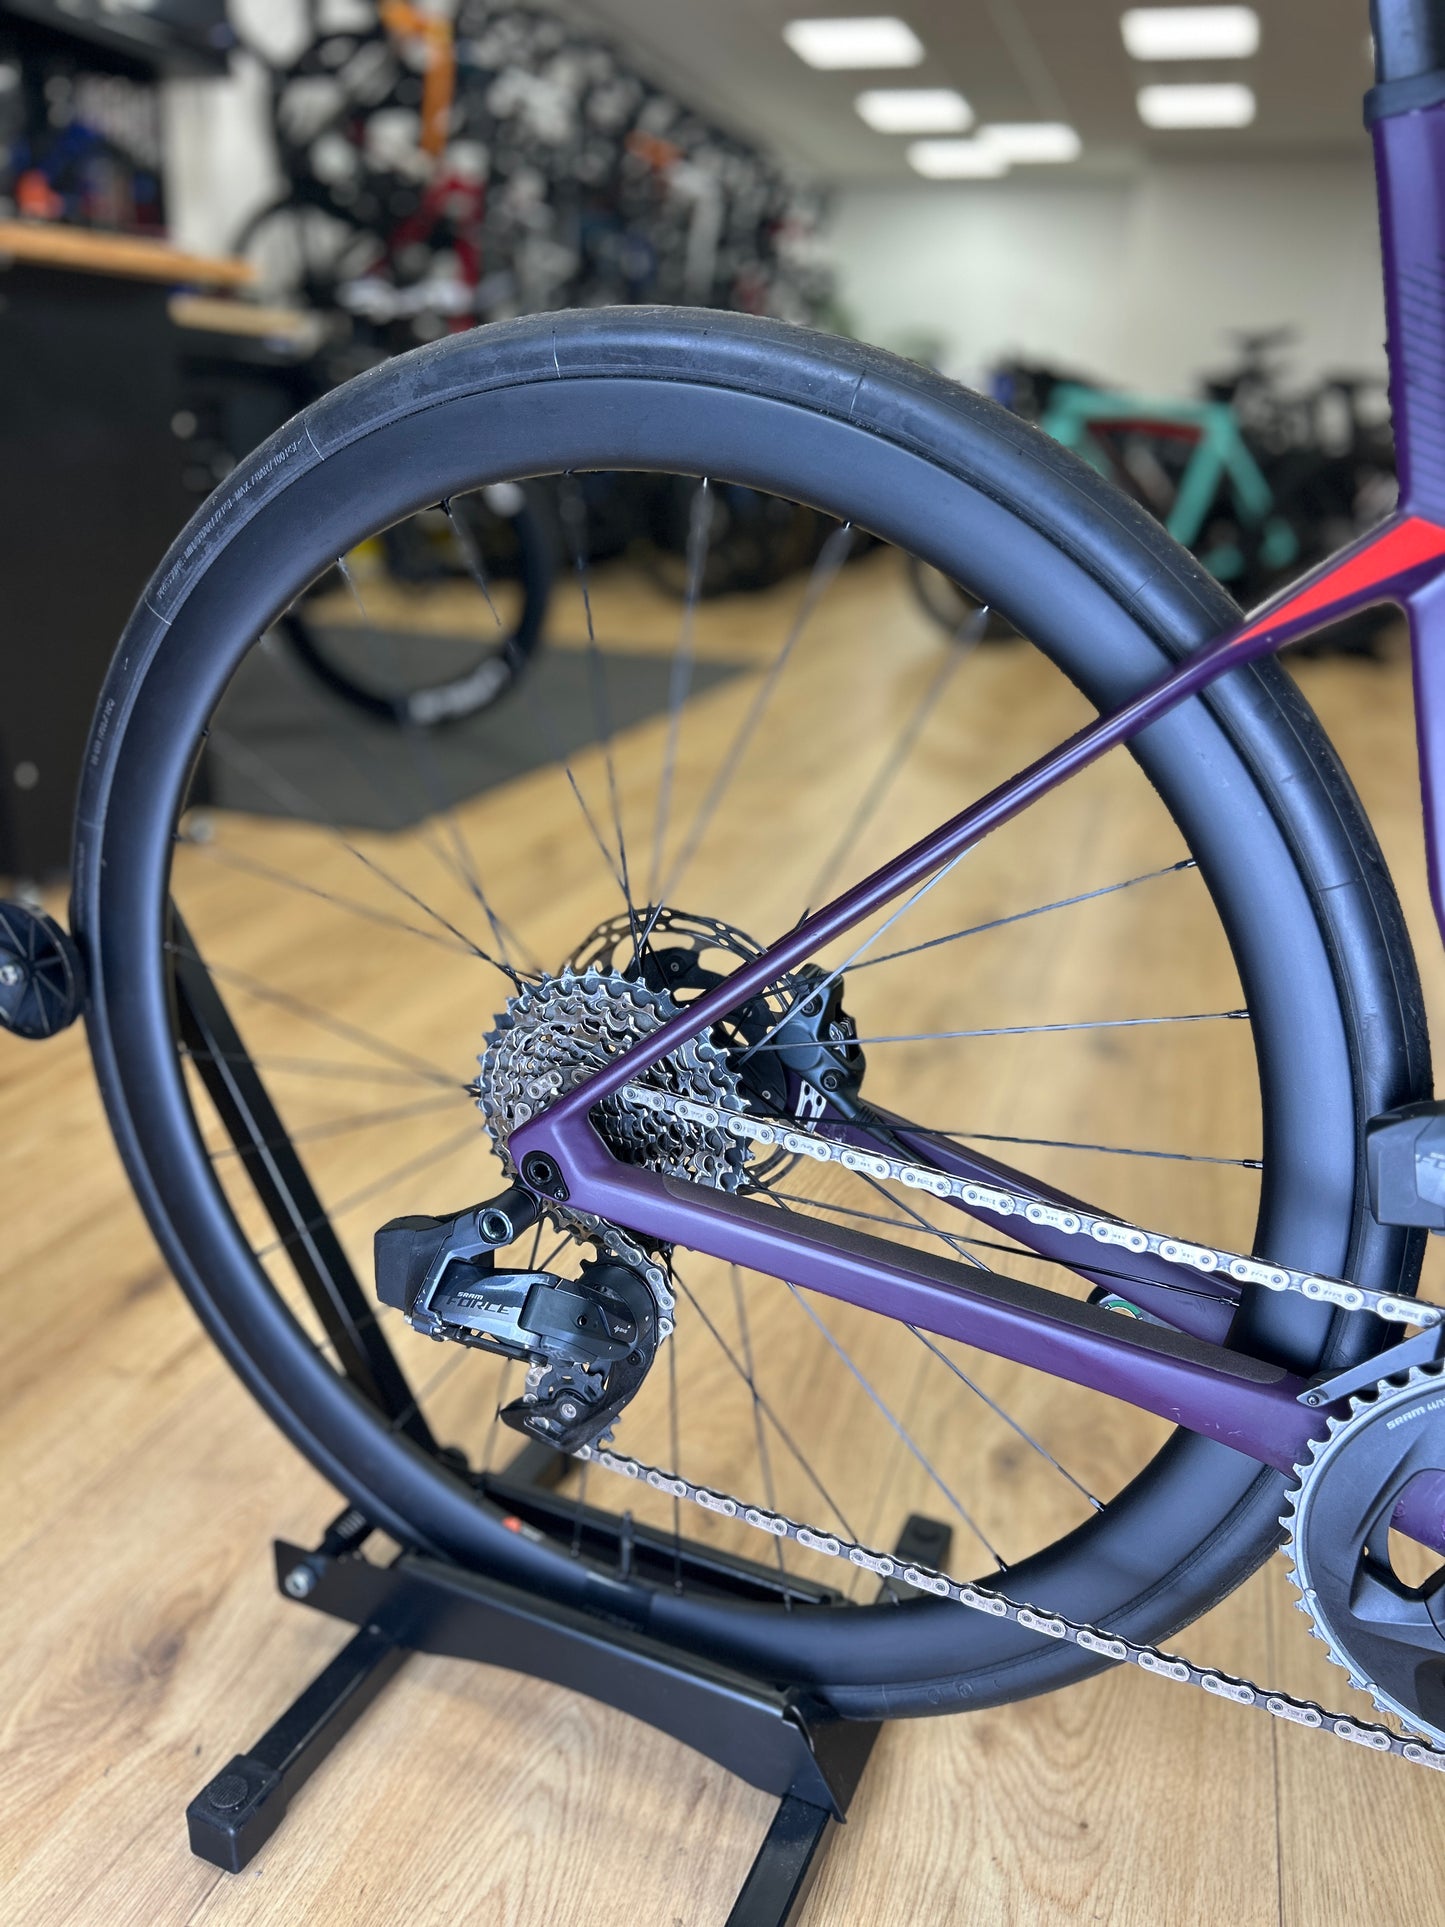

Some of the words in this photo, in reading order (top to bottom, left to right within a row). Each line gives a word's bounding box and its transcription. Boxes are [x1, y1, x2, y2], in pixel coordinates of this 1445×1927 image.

[457, 1291, 484, 1300] SRAM
[446, 1297, 509, 1315] FORCE
[1386, 1406, 1426, 1430] SRAM
